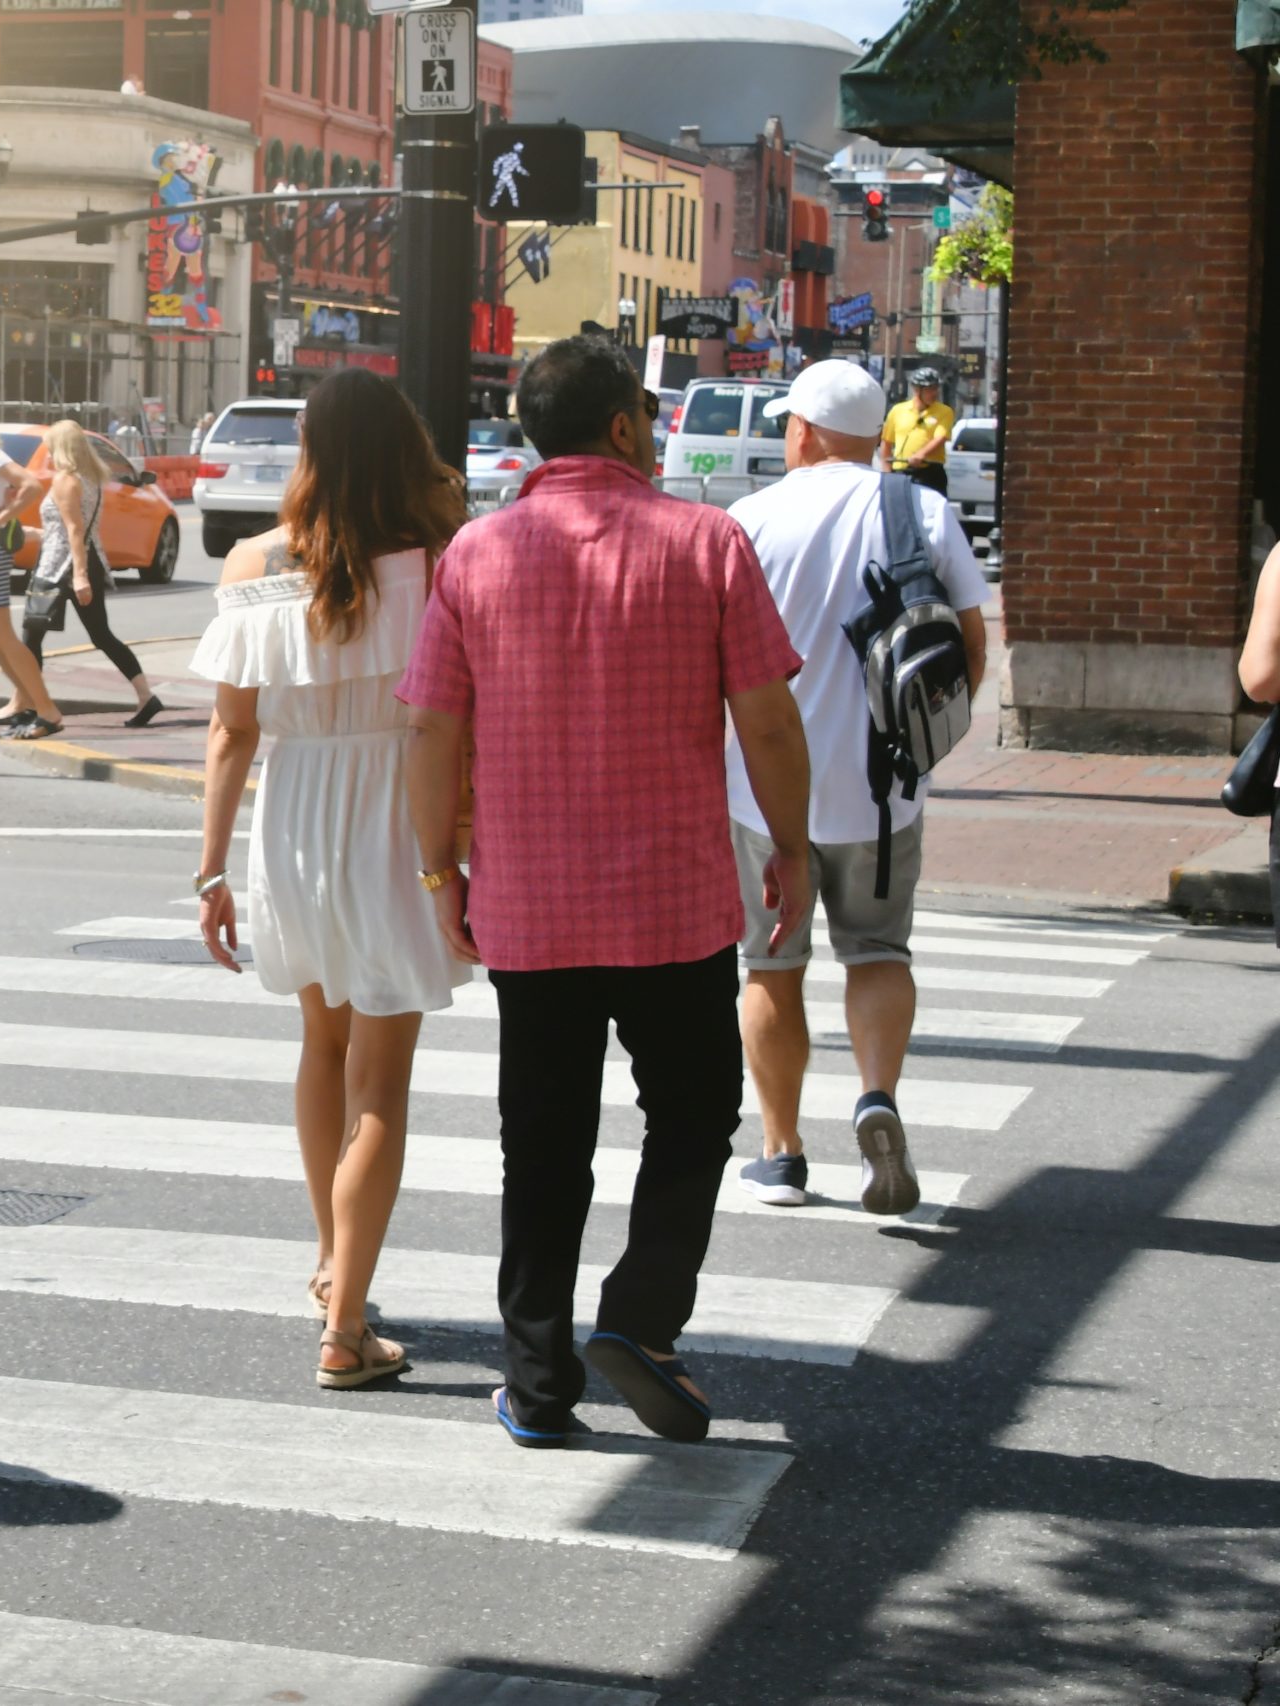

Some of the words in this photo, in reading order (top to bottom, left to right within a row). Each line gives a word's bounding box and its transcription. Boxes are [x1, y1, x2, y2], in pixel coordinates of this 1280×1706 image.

[419, 14, 456, 28] CROSS
[422, 29, 452, 43] ONLY
[430, 44, 445, 57] ON
[419, 95, 456, 107] SIGNAL
[148, 293, 182, 317] 32
[687, 323, 717, 338] MOJO
